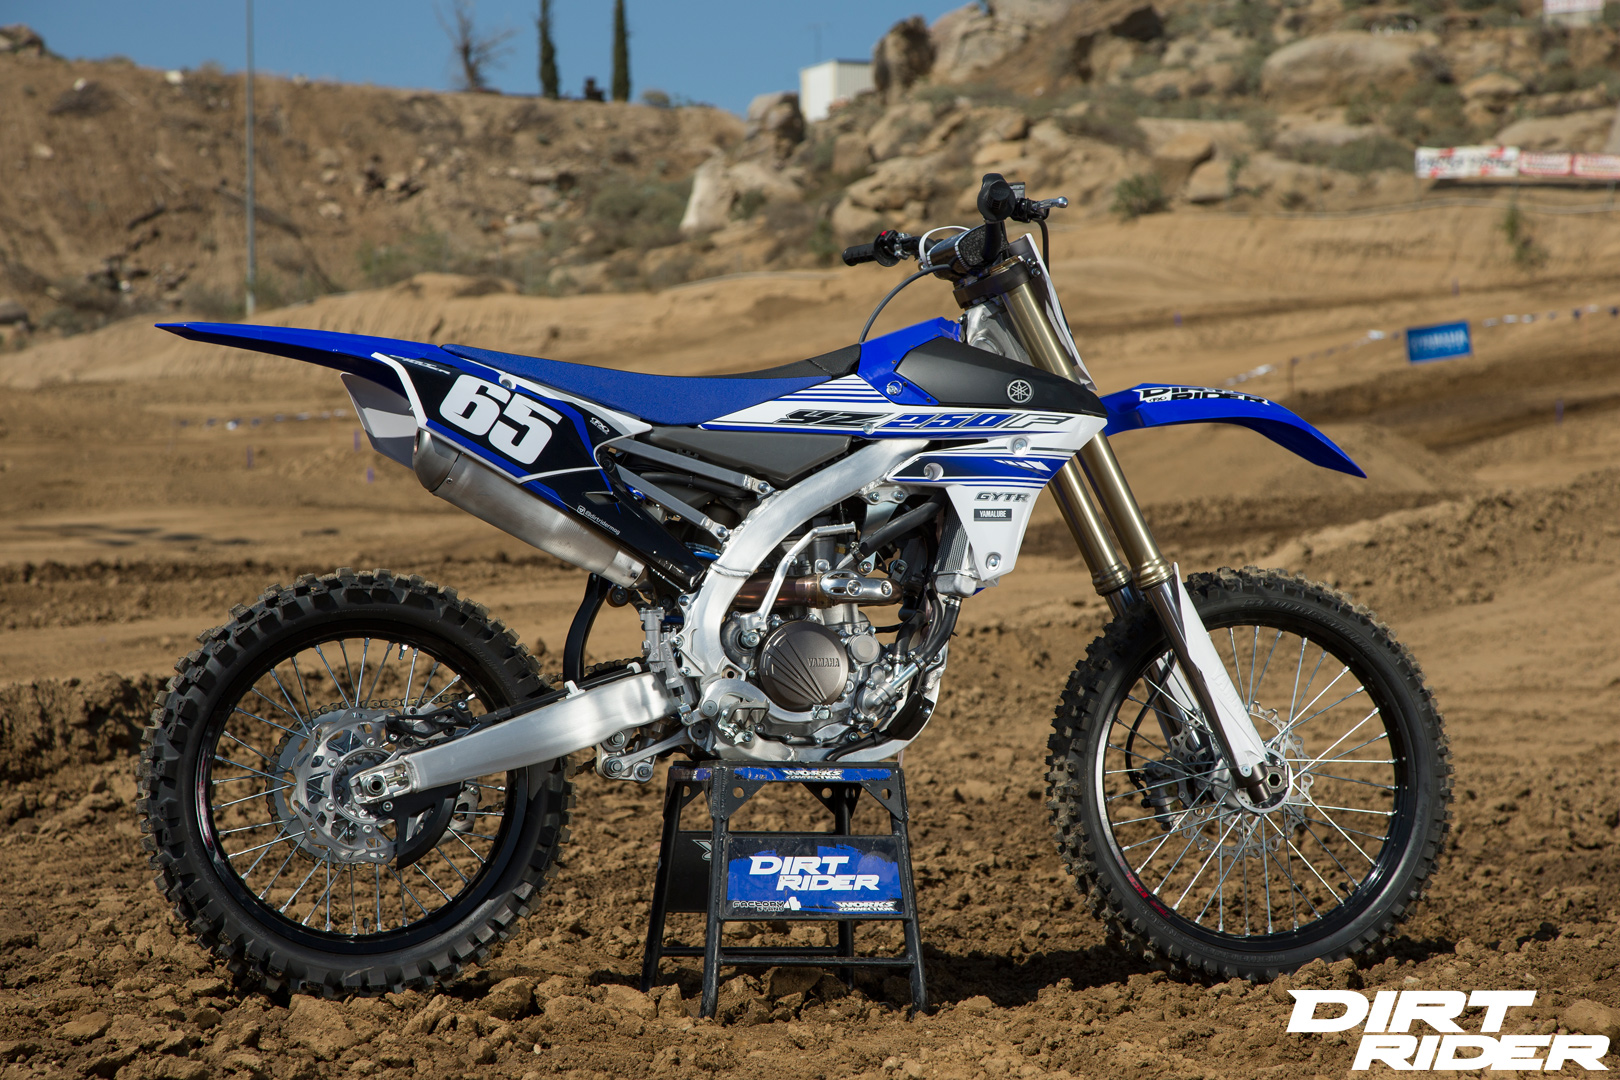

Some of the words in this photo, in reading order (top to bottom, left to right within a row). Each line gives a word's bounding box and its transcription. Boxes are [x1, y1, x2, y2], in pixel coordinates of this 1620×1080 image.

[439, 374, 563, 465] 65
[974, 491, 1031, 503] GYTR
[979, 510, 1007, 518] YAMALUBE
[808, 657, 840, 668] YAMAHA
[781, 768, 844, 776] WORKS
[749, 856, 849, 875] DIRT
[776, 874, 880, 891] RIDER
